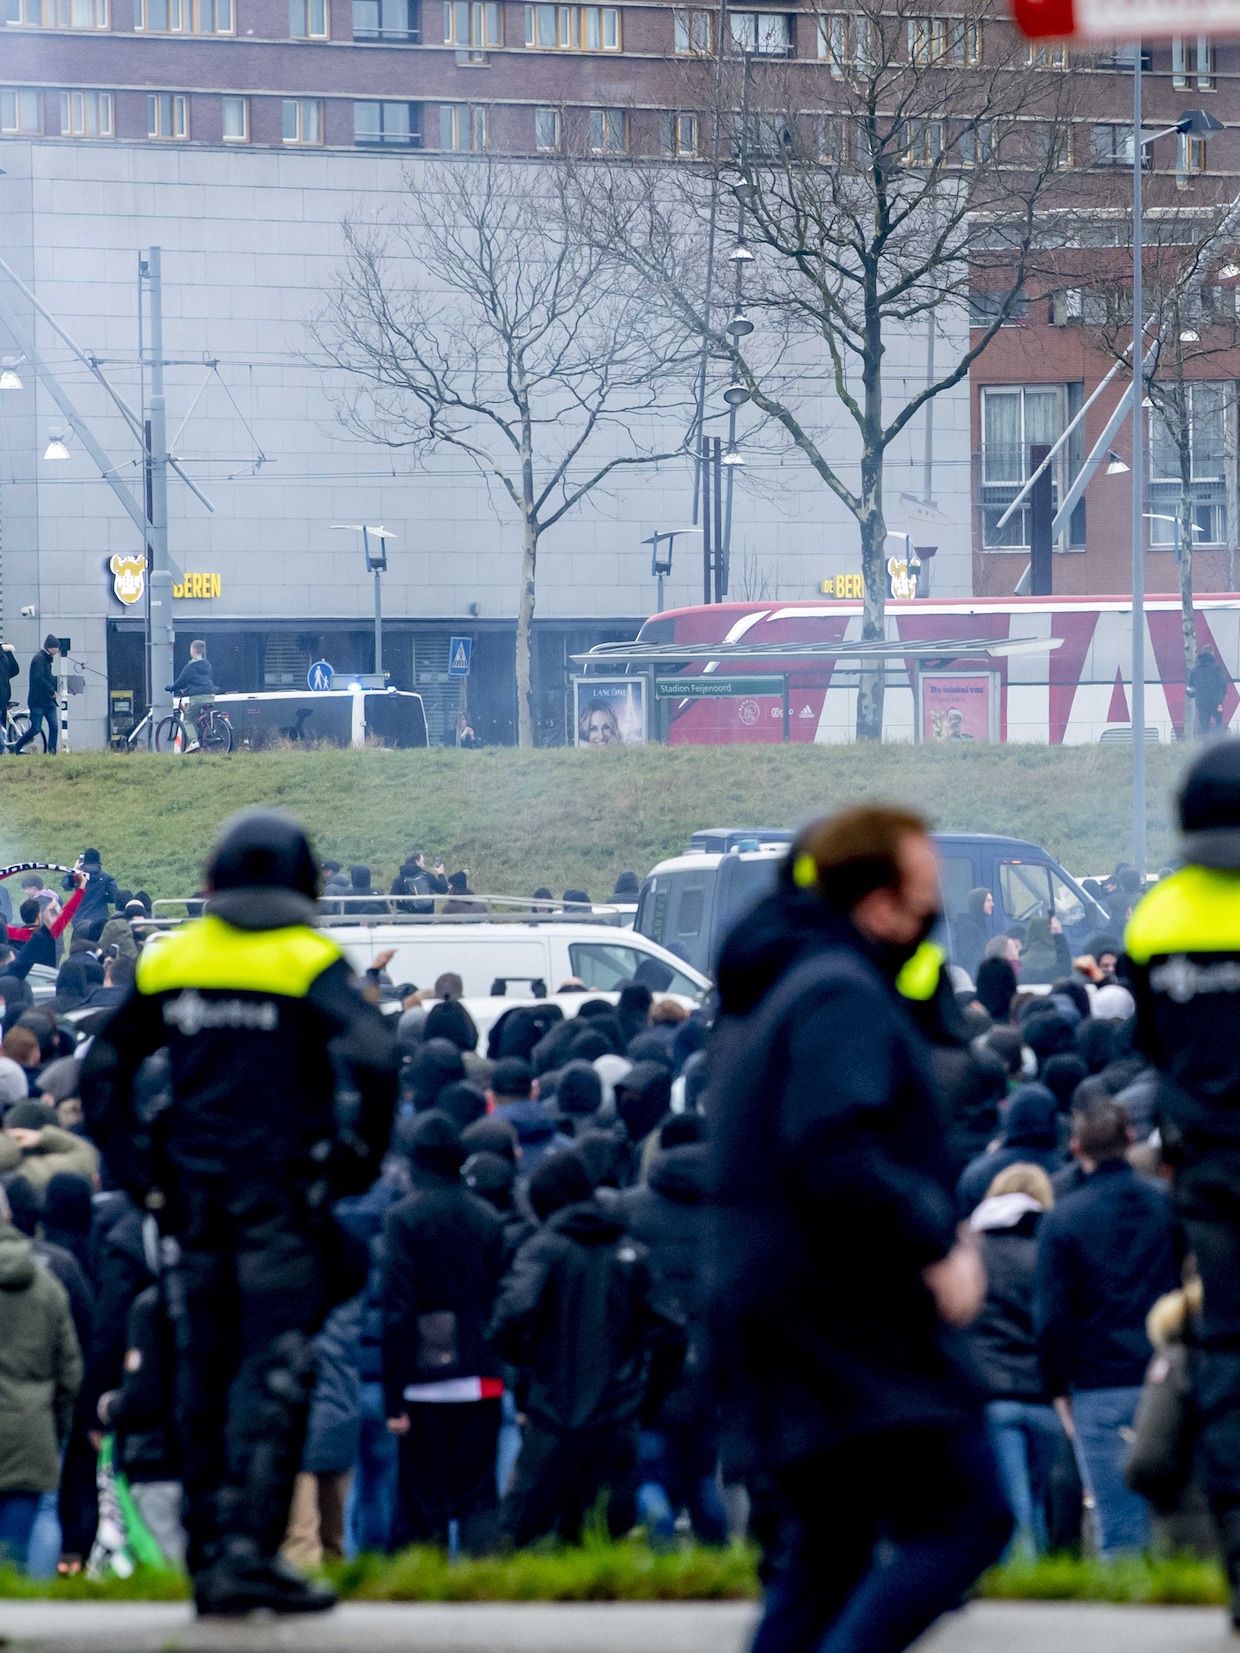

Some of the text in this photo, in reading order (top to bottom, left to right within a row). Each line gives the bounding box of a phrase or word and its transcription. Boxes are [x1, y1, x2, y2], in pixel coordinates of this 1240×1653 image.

[823, 574, 864, 599] DE BER
[660, 683, 732, 695] Stadion Feijenoord
